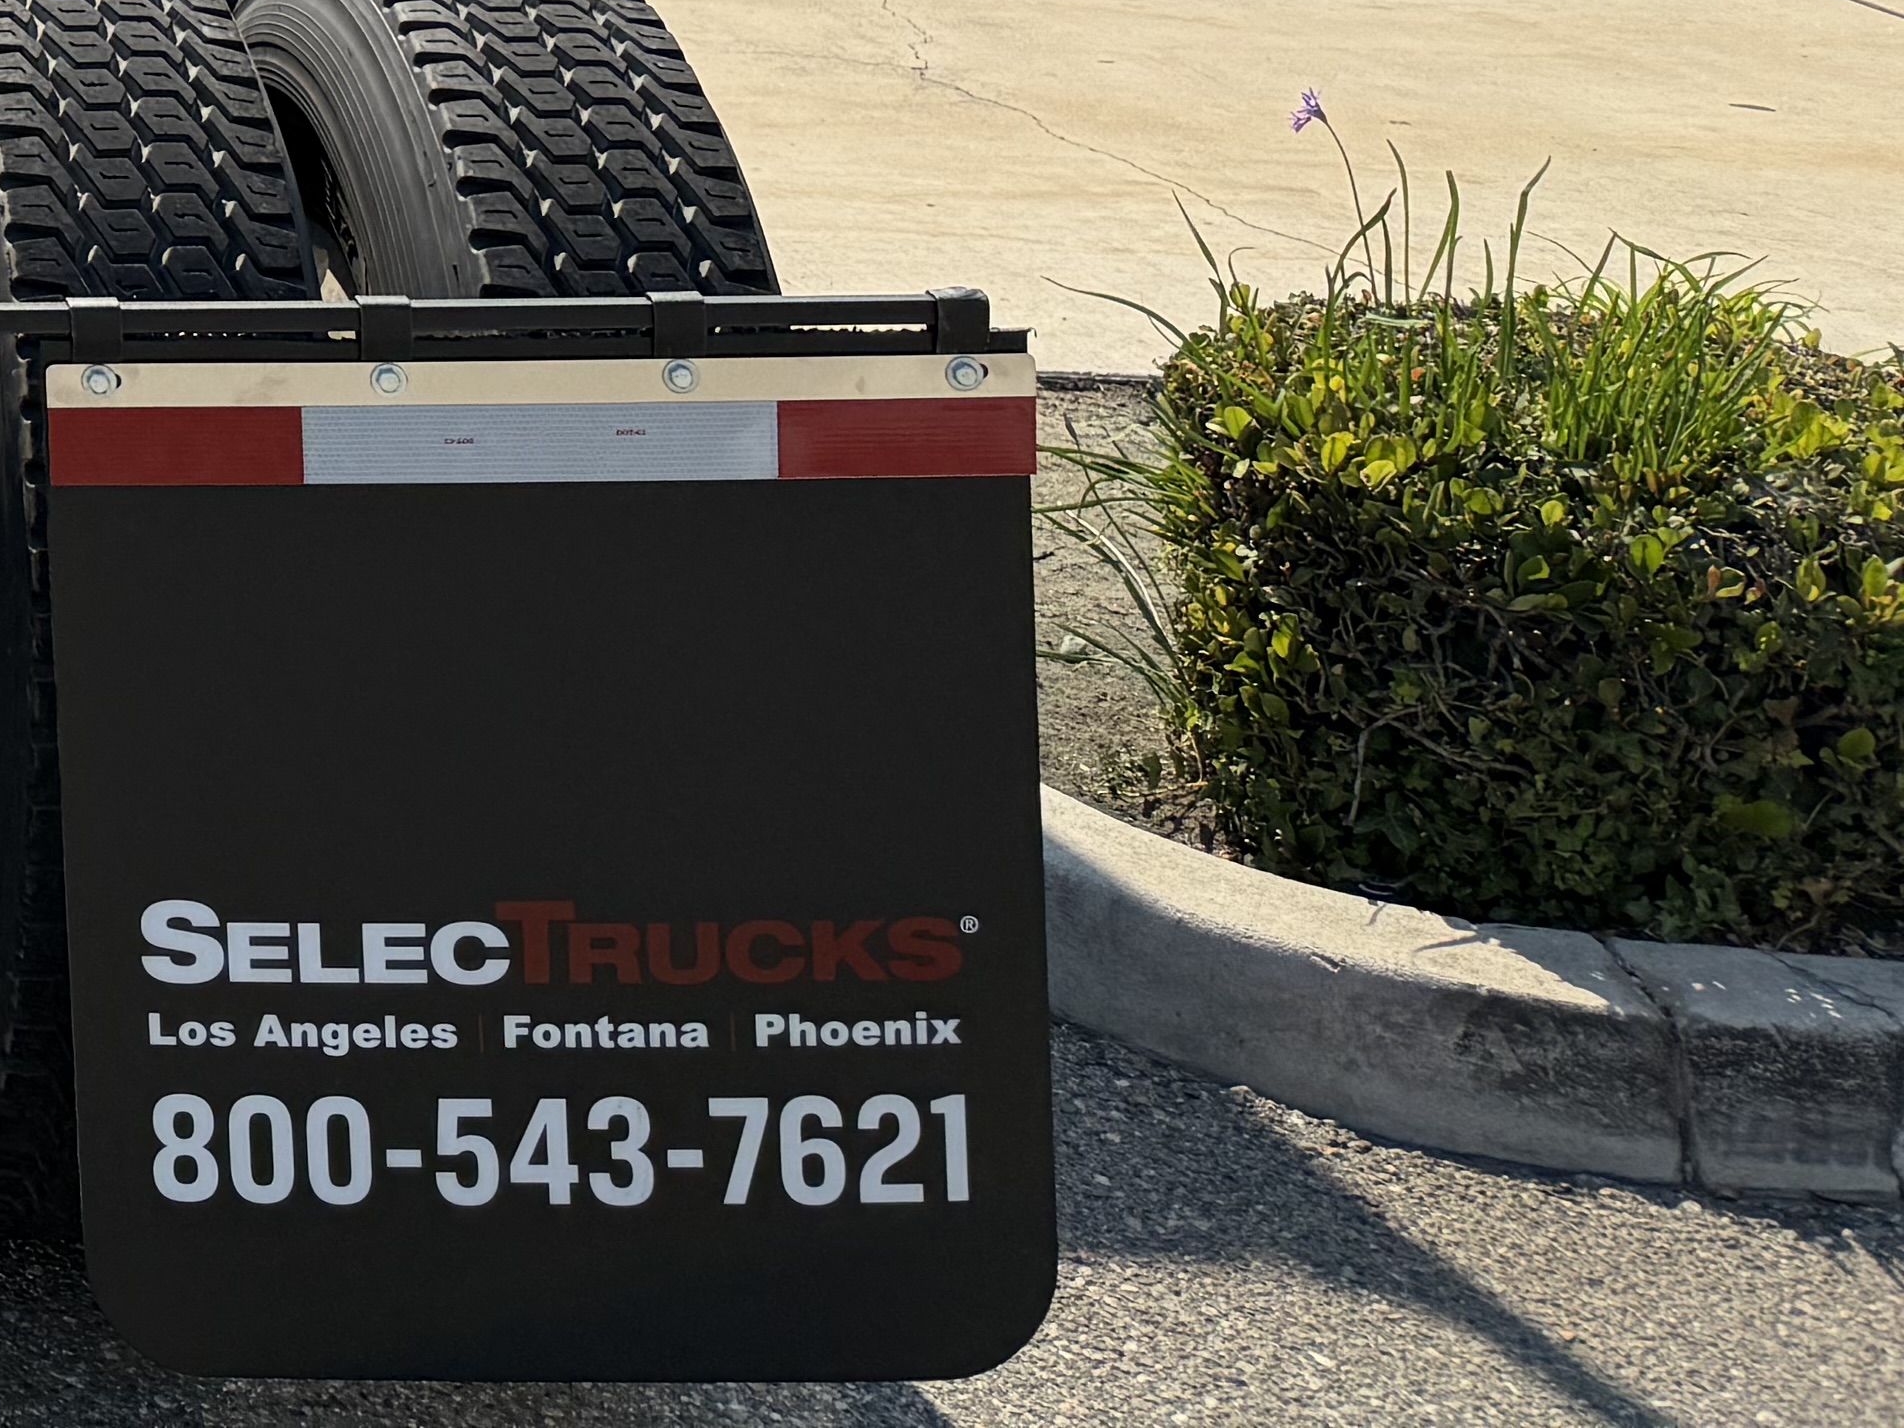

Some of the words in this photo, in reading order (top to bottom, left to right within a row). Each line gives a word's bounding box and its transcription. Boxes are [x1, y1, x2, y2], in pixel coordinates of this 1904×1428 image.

[149, 1013, 237, 1047] Los
[253, 1015, 458, 1056] Angeles
[504, 1015, 710, 1049] Fontana
[755, 1012, 962, 1048] Phoenix
[152, 1093, 970, 1207] 800-543-7621
